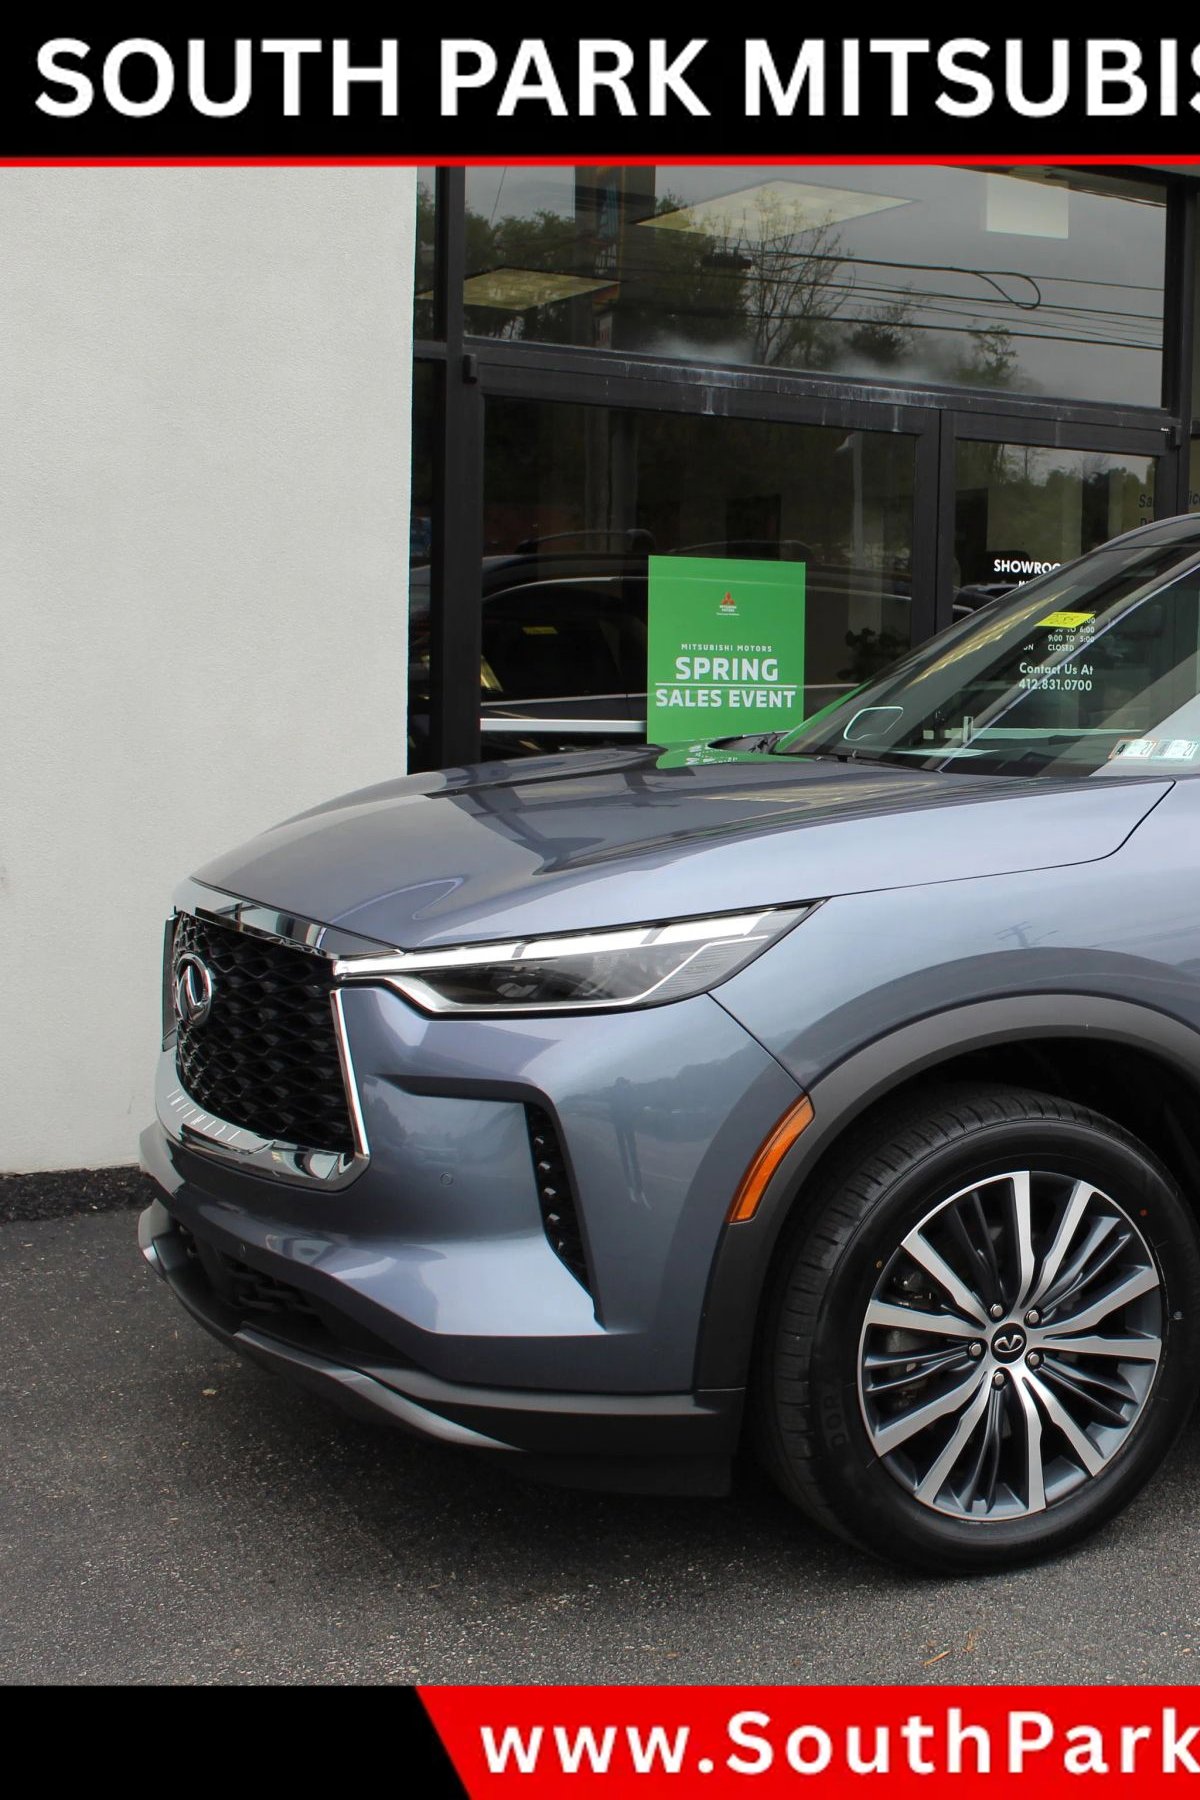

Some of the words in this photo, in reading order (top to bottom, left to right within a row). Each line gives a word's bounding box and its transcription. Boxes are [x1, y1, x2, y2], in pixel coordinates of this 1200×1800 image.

[681, 643, 733, 651] MITSUBISHI
[1047, 644, 1075, 652] CLOSED
[675, 656, 779, 682] SPRING
[1019, 662, 1061, 674] Contact
[1064, 663, 1078, 675] Us
[1080, 664, 1093, 675] At
[1018, 678, 1093, 691] 412.831.0700
[655, 688, 722, 708] SALES
[729, 690, 796, 708] EVENT
